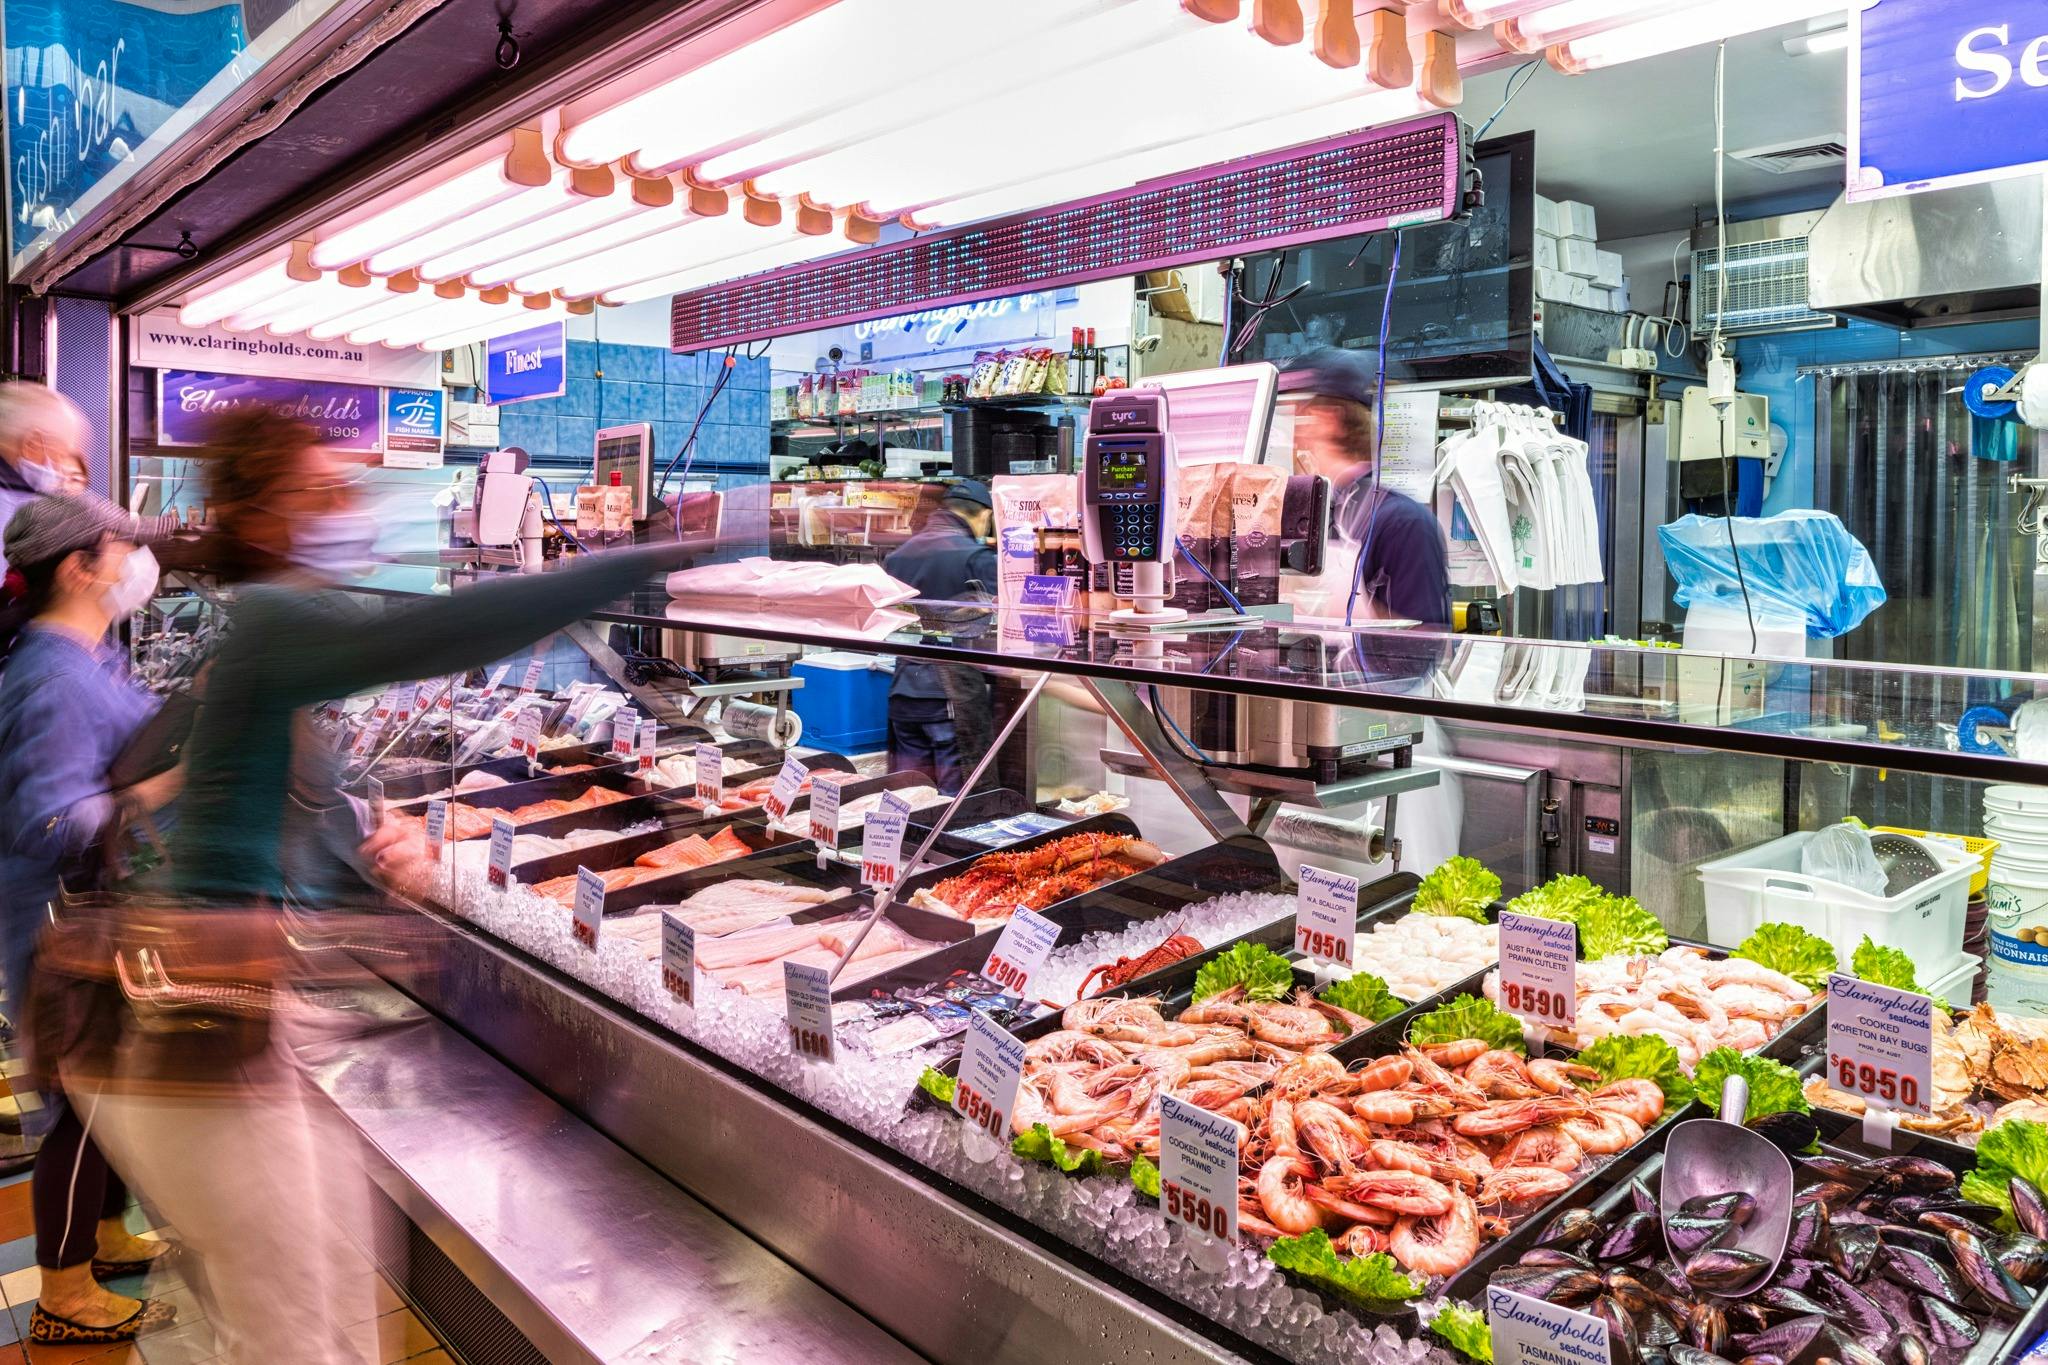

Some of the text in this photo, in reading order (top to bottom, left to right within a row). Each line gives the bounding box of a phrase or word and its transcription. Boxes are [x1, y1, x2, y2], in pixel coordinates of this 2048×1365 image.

[701, 149, 1351, 339] CLARINGBOLDS SEAFOODS
[149, 332, 363, 361] www.claringbolds.com.au
[505, 344, 543, 375] Finest
[1112, 410, 1137, 422] tyro
[328, 427, 360, 437] 1909
[411, 427, 435, 435] NAMES
[1019, 500, 1042, 512] STOCK
[1300, 866, 1356, 893] Claringbolds
[1318, 899, 1347, 913] SCALLOPS
[1332, 891, 1356, 903] seafoods
[1311, 910, 1337, 924] PREMIUM
[1499, 913, 1573, 941] Claringbolds
[1024, 936, 1044, 952] COOKED
[1506, 943, 1569, 962] AUST RAW GREEN
[1543, 940, 1574, 952] seafoods
[2005, 940, 2019, 949] EGG
[1508, 952, 1567, 972] PRAWN CUTLETS
[803, 1001, 815, 1011] MEAT
[1829, 976, 1930, 1017] Claringbolds
[1858, 1015, 1900, 1034] COOKED
[1888, 1012, 1930, 1030] seafoods
[970, 1010, 1025, 1063] Claringbolds
[1831, 1022, 1929, 1054] MORETON BAY BUGS
[975, 1048, 1007, 1079] GREEN KING
[976, 1060, 1000, 1084] PRAWNS
[998, 1052, 1021, 1074] seafoods
[1918, 1100, 1931, 1113] kg
[1160, 1095, 1237, 1145] Claringbolds
[1168, 1135, 1227, 1169] COOKED WHOLE
[1204, 1138, 1237, 1159] seafoods
[1181, 1154, 1213, 1175] PRAWNS
[1488, 1290, 1606, 1347] Claringbolds
[1518, 1342, 1582, 1365] TASMANIAN
[1559, 1341, 1608, 1365] seafoods
